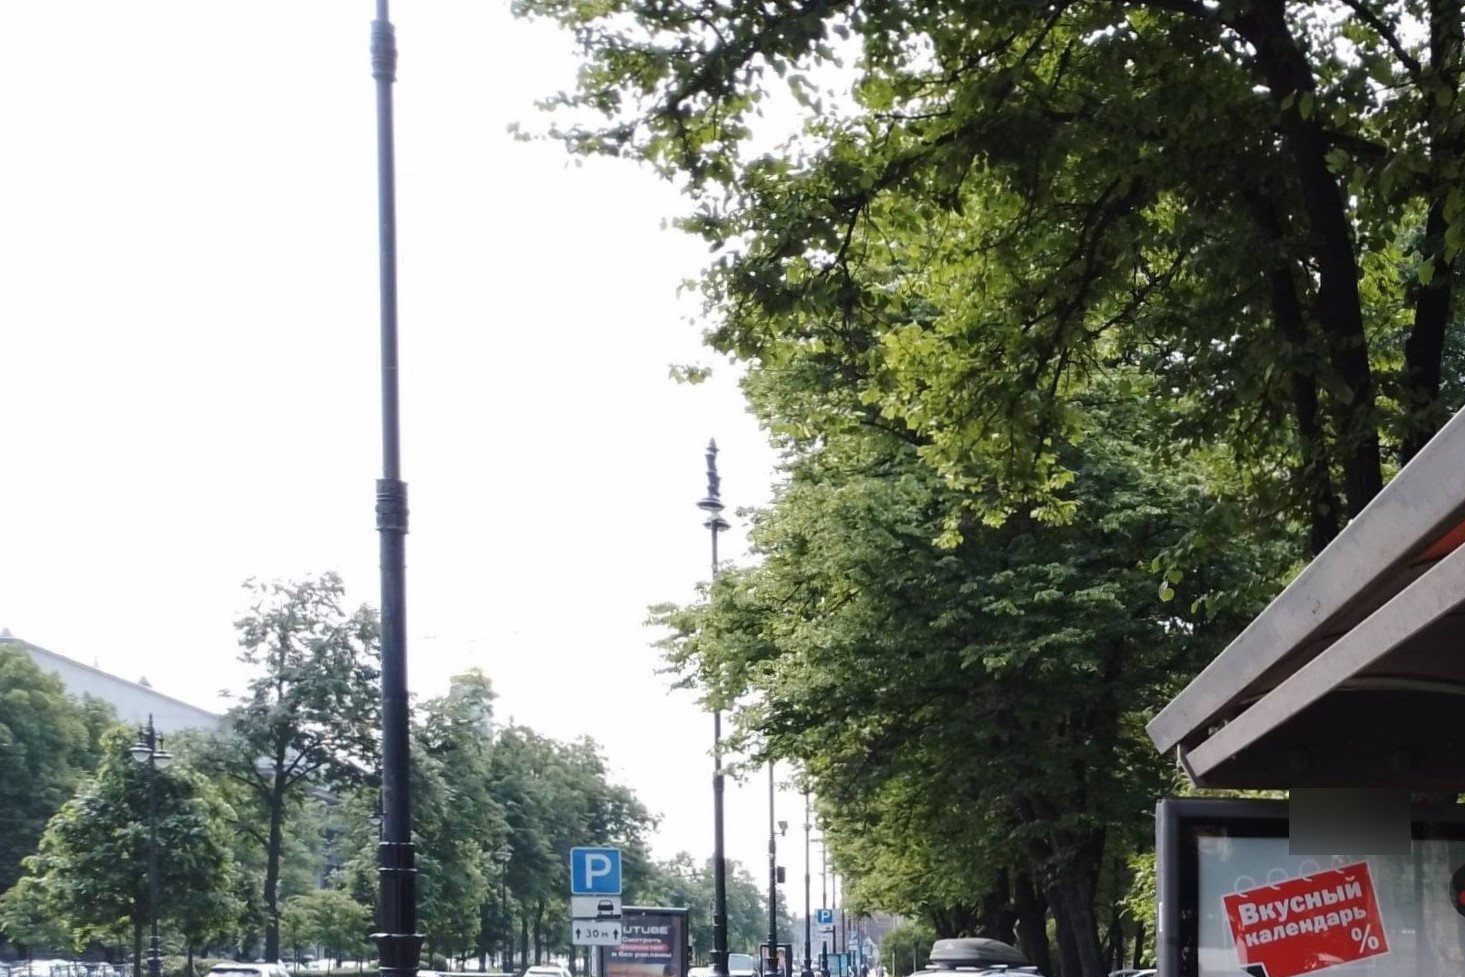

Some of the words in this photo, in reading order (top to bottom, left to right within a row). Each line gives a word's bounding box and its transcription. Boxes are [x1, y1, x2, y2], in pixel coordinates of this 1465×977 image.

[585, 853, 612, 889] P
[1238, 876, 1363, 927] Вкусный
[585, 928, 600, 938] 30
[622, 926, 669, 935] UTUBE
[1244, 905, 1367, 948] календарь
[1350, 923, 1380, 954] %
